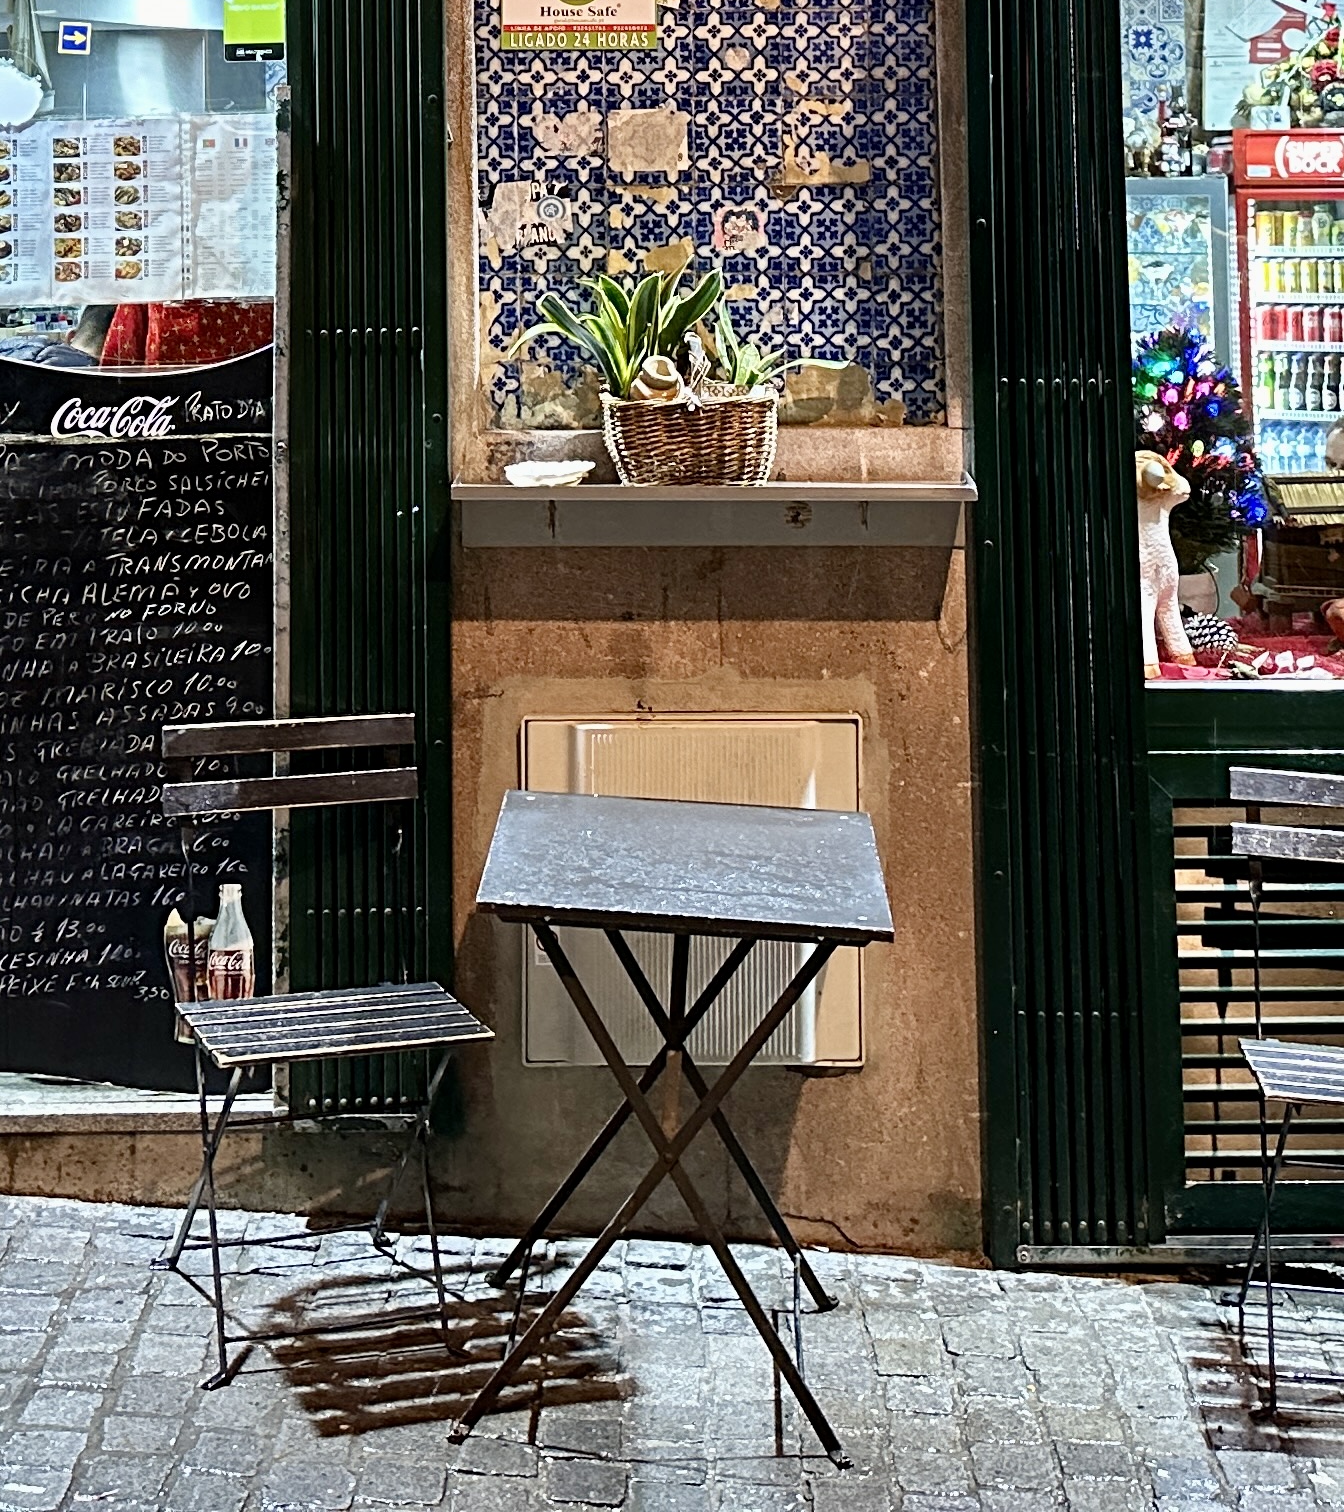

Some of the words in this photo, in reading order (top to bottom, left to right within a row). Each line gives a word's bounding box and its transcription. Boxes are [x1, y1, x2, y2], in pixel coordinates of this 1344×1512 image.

[540, 5, 583, 17] House
[510, 32, 567, 48] LIGADO
[573, 32, 591, 47] 24
[597, 32, 649, 48] HORAS
[50, 396, 180, 439] Coca-Cola
[184, 390, 233, 422] PRATO
[59, 448, 153, 472] MODA
[162, 450, 187, 465] DO
[199, 438, 270, 463] PORTO
[208, 581, 252, 600] OVO
[4, 611, 33, 630] DE
[104, 608, 133, 622] NO
[141, 599, 217, 622] FORNO
[86, 642, 226, 674] BRASILEIRA
[94, 701, 216, 727] ASSADAS
[57, 785, 165, 812] GRELHAD
